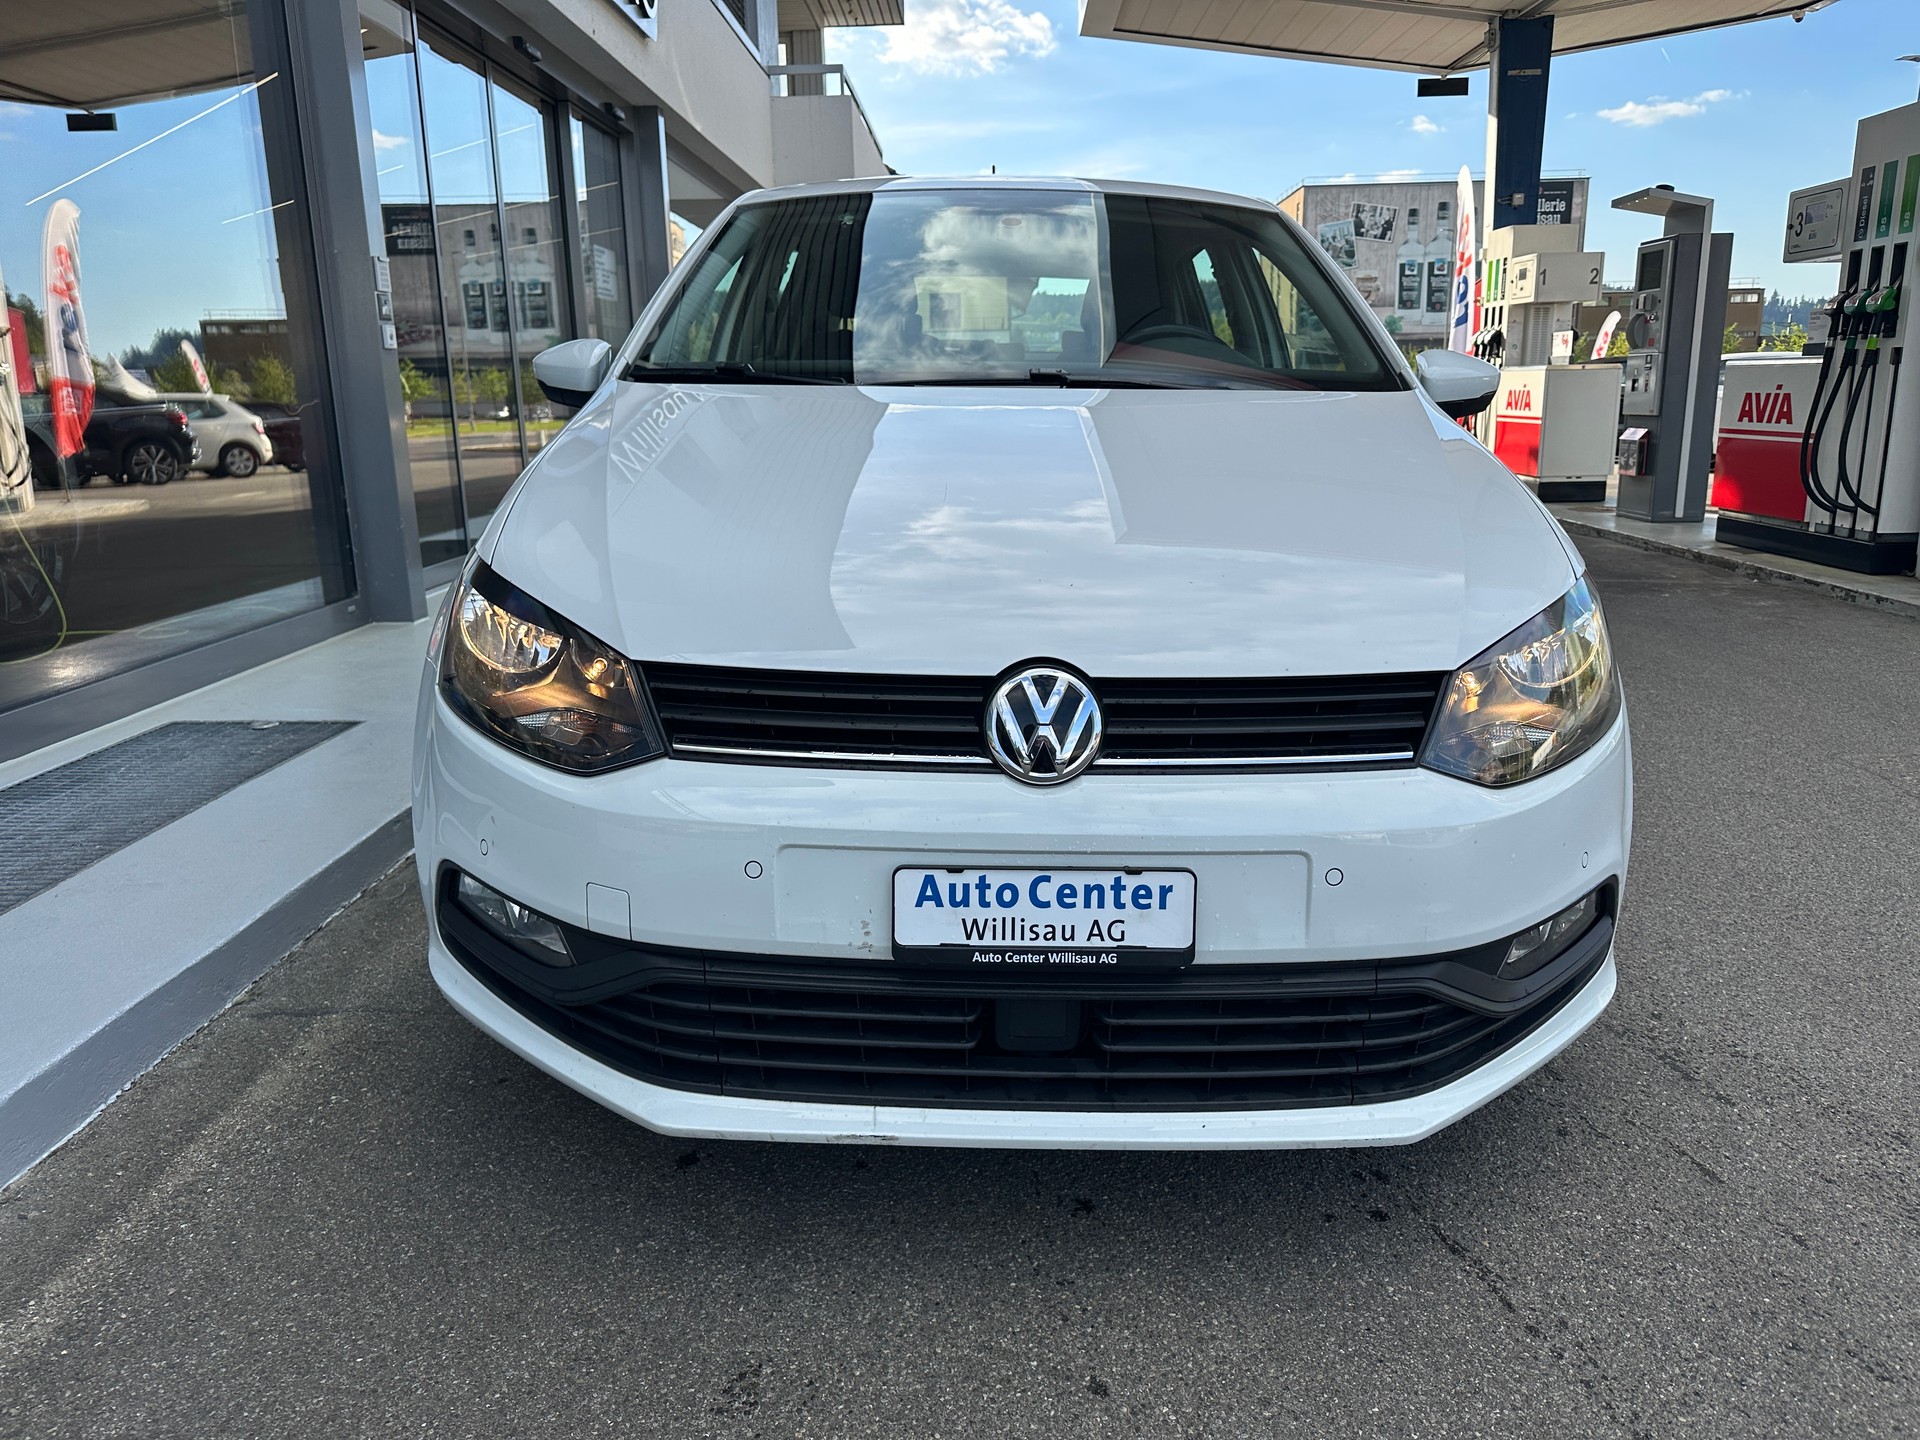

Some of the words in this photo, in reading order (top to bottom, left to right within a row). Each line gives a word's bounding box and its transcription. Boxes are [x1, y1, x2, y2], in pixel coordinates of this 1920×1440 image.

[1794, 211, 1804, 237] 3
[1540, 268, 1547, 286] 1
[1589, 267, 1600, 285] 2
[914, 874, 1020, 909] Auto
[1028, 874, 1174, 911] Center
[961, 916, 1076, 942] Willisau
[1086, 919, 1126, 942] AG
[972, 951, 1002, 963] Auto
[1005, 951, 1045, 964] Center
[1048, 951, 1097, 964] Willisau
[1099, 953, 1118, 965] AG
